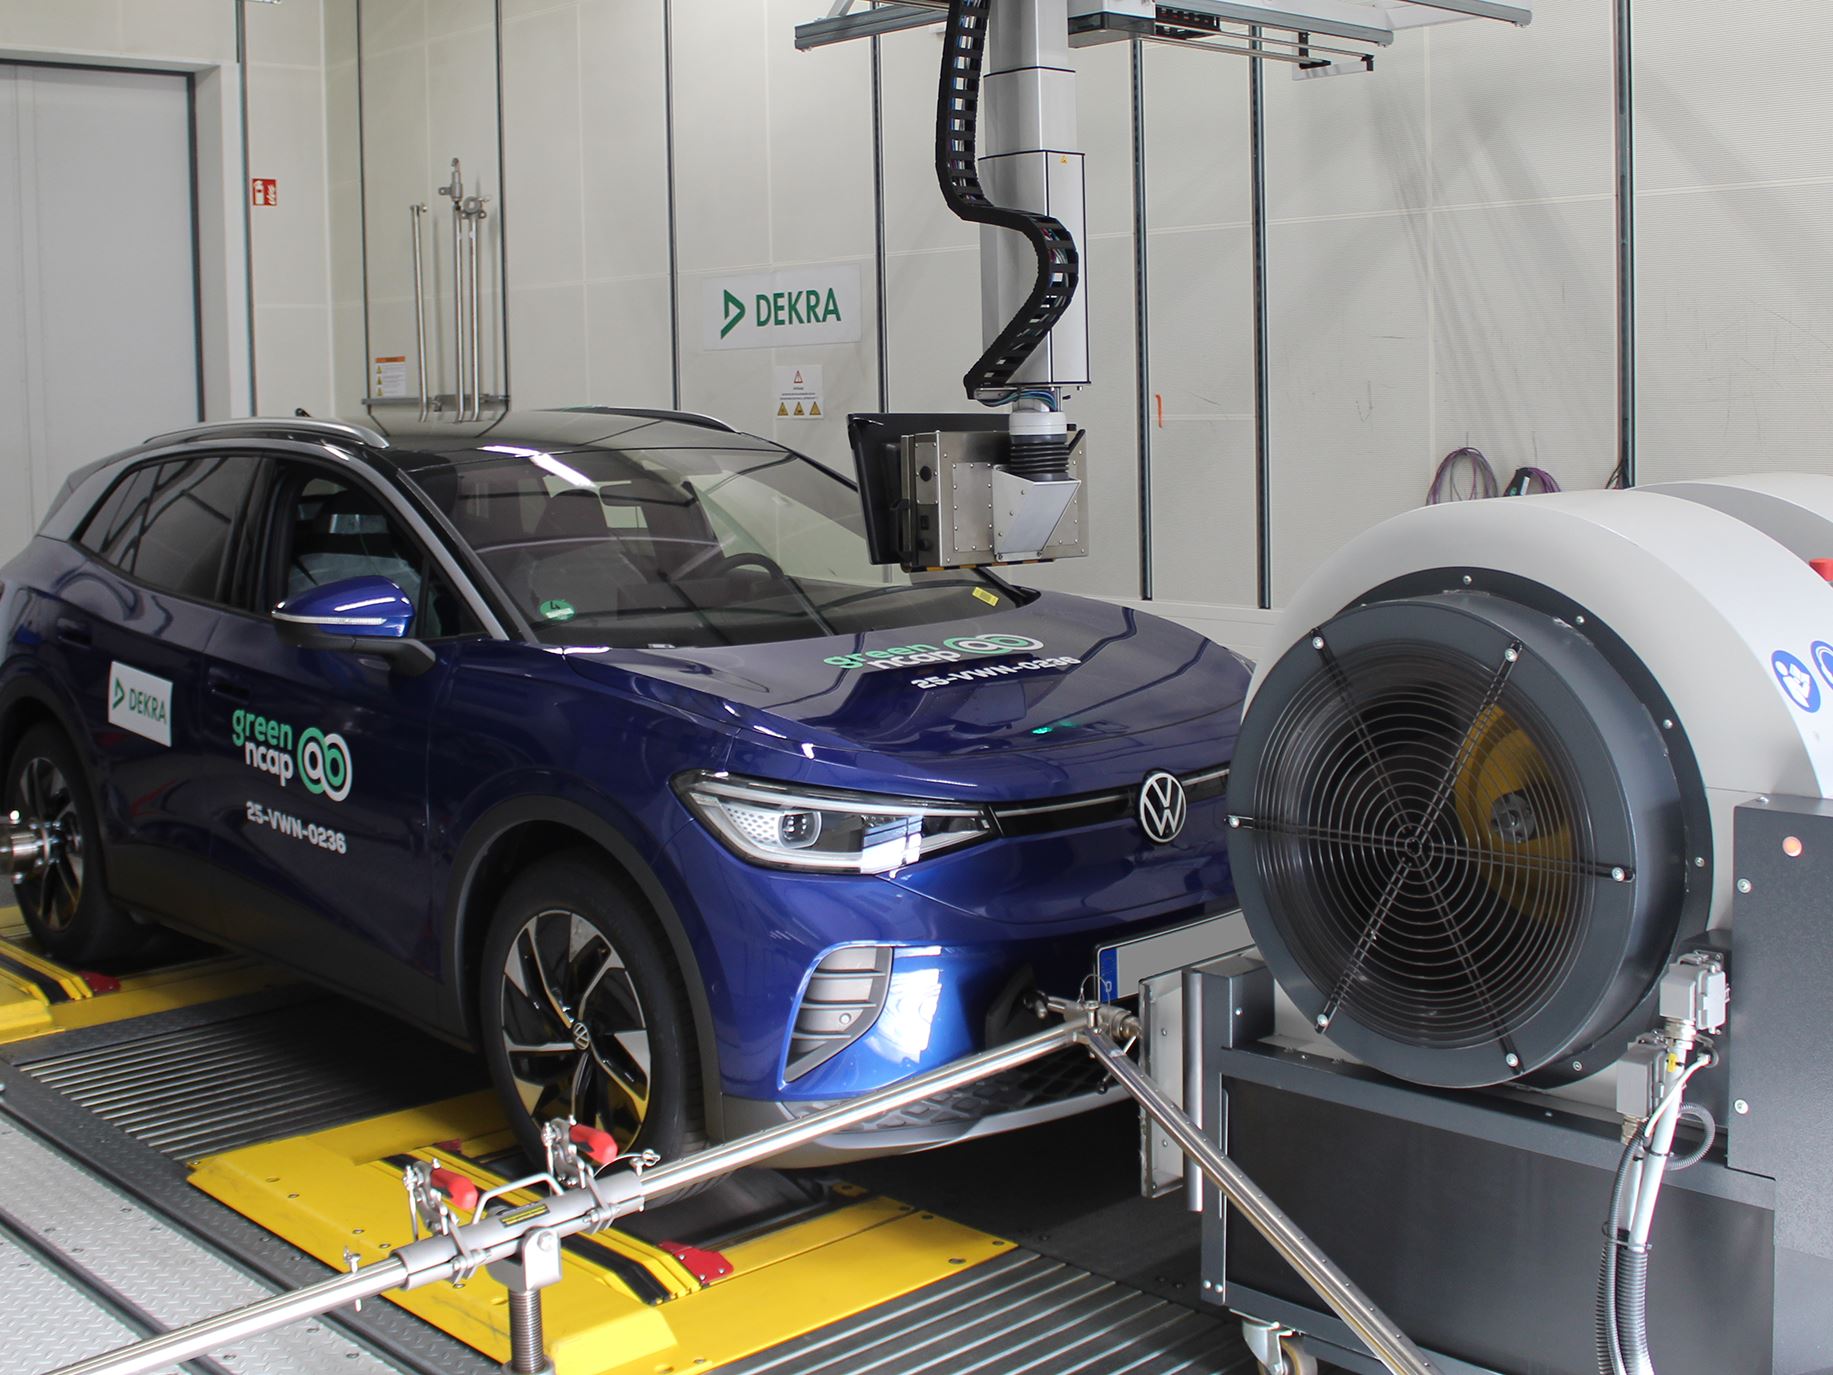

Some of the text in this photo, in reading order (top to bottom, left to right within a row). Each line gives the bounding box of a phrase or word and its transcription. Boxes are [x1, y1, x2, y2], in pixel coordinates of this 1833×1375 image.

[755, 287, 842, 327] DEKRA
[823, 644, 939, 669] green
[866, 650, 961, 670] ncap
[911, 656, 1081, 689] 25-VWN-0236
[129, 688, 167, 725] DEKRA
[232, 708, 292, 750] green
[245, 741, 294, 786] ncap
[246, 800, 346, 854] 25-VWN-0236
